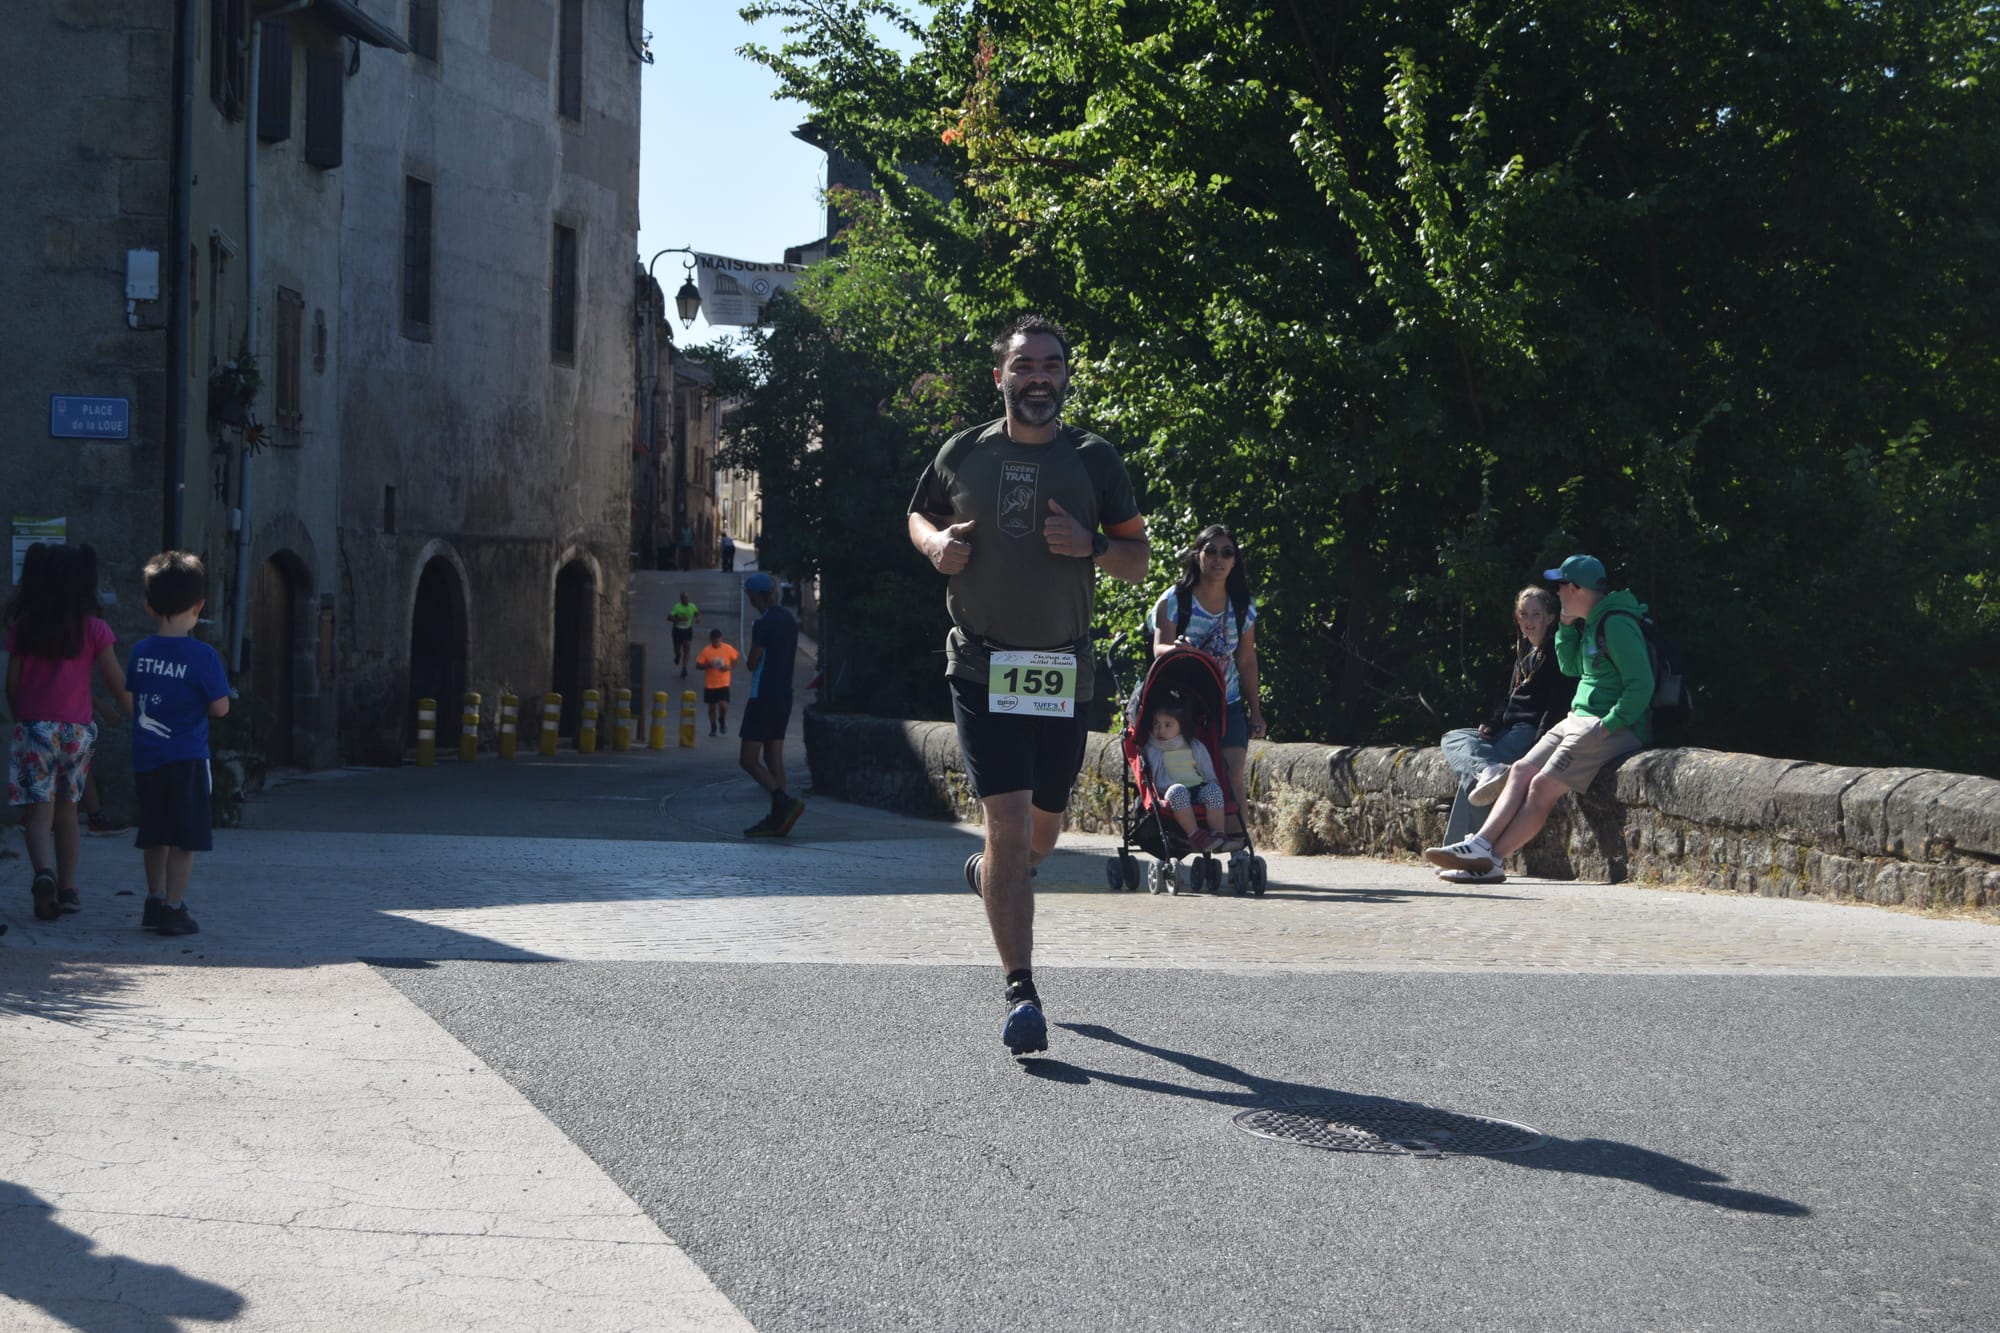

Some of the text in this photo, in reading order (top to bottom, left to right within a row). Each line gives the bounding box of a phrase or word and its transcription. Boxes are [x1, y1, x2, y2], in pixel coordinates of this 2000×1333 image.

[701, 256, 769, 273] MAISON
[82, 404, 113, 416] PLACE
[72, 420, 124, 432] de la LOUE
[1005, 472, 1034, 482] TRAIL
[136, 657, 188, 680] ETHAN
[1003, 667, 1064, 695] 159
